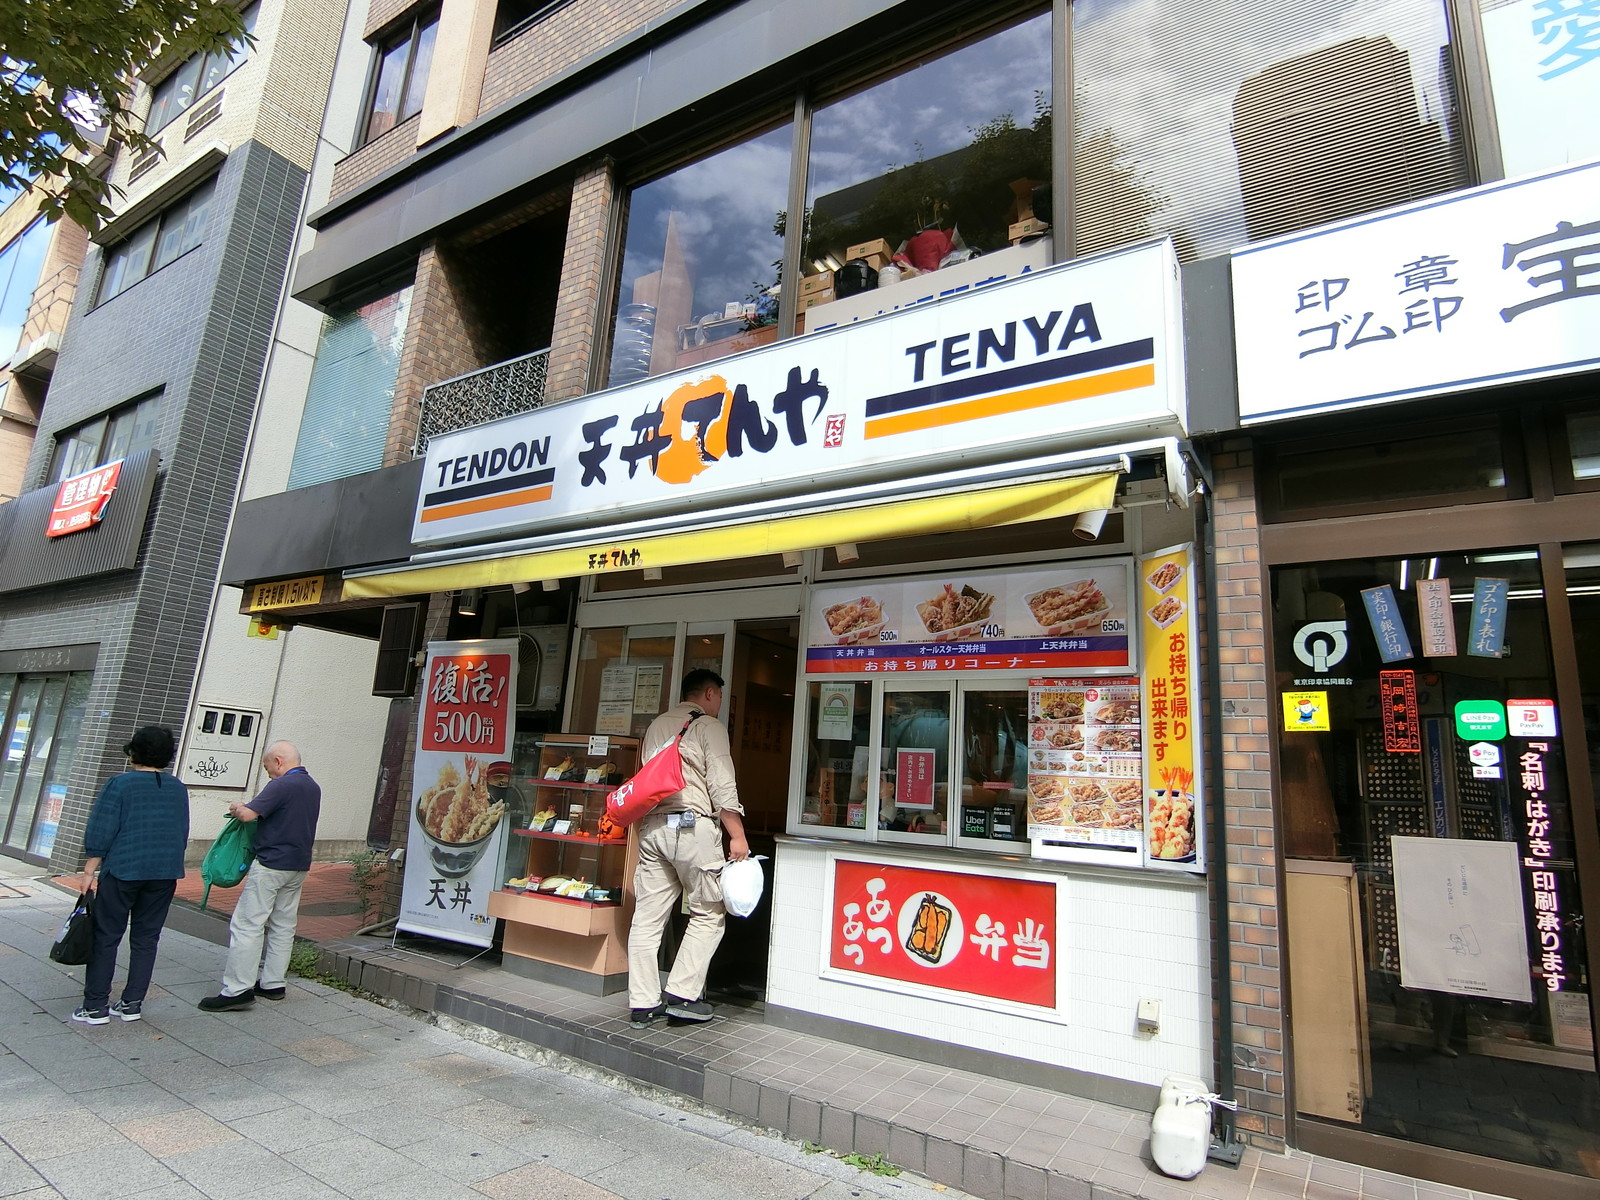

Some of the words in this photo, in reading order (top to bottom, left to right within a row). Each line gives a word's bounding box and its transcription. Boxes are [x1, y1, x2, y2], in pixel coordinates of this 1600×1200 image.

[1295, 255, 1459, 314] 印章
[905, 302, 1102, 382] TENYA
[1298, 296, 1464, 359] ゴム印
[578, 366, 830, 487] 天丼てんや
[825, 415, 845, 447] てんや
[437, 435, 551, 487] TENDON
[588, 548, 641, 569] 天丼てんや
[980, 624, 1005, 638] 740円
[1102, 620, 1125, 631] 650円
[1372, 592, 1402, 656] 実印・銀行印
[1476, 583, 1502, 652] ゴム印・表札
[836, 648, 875, 657] 天丼弁当
[880, 631, 898, 641] 500円
[919, 643, 986, 654] オールスター天丼弁当
[1039, 640, 1088, 650] 上天丼弁当
[864, 656, 1046, 672] お持ち帰りコーナー
[1169, 632, 1188, 741] お持ち帰り
[1293, 678, 1354, 686] 東京印章協同組合
[434, 711, 495, 745] 500円
[1151, 677, 1169, 762] 出来ます
[965, 815, 985, 824] Uber
[965, 824, 985, 832] Eats
[1520, 742, 1566, 992] 『名刺・はがき』印刷承ります
[425, 878, 472, 914] 天丼
[970, 913, 1050, 969] 弁当
